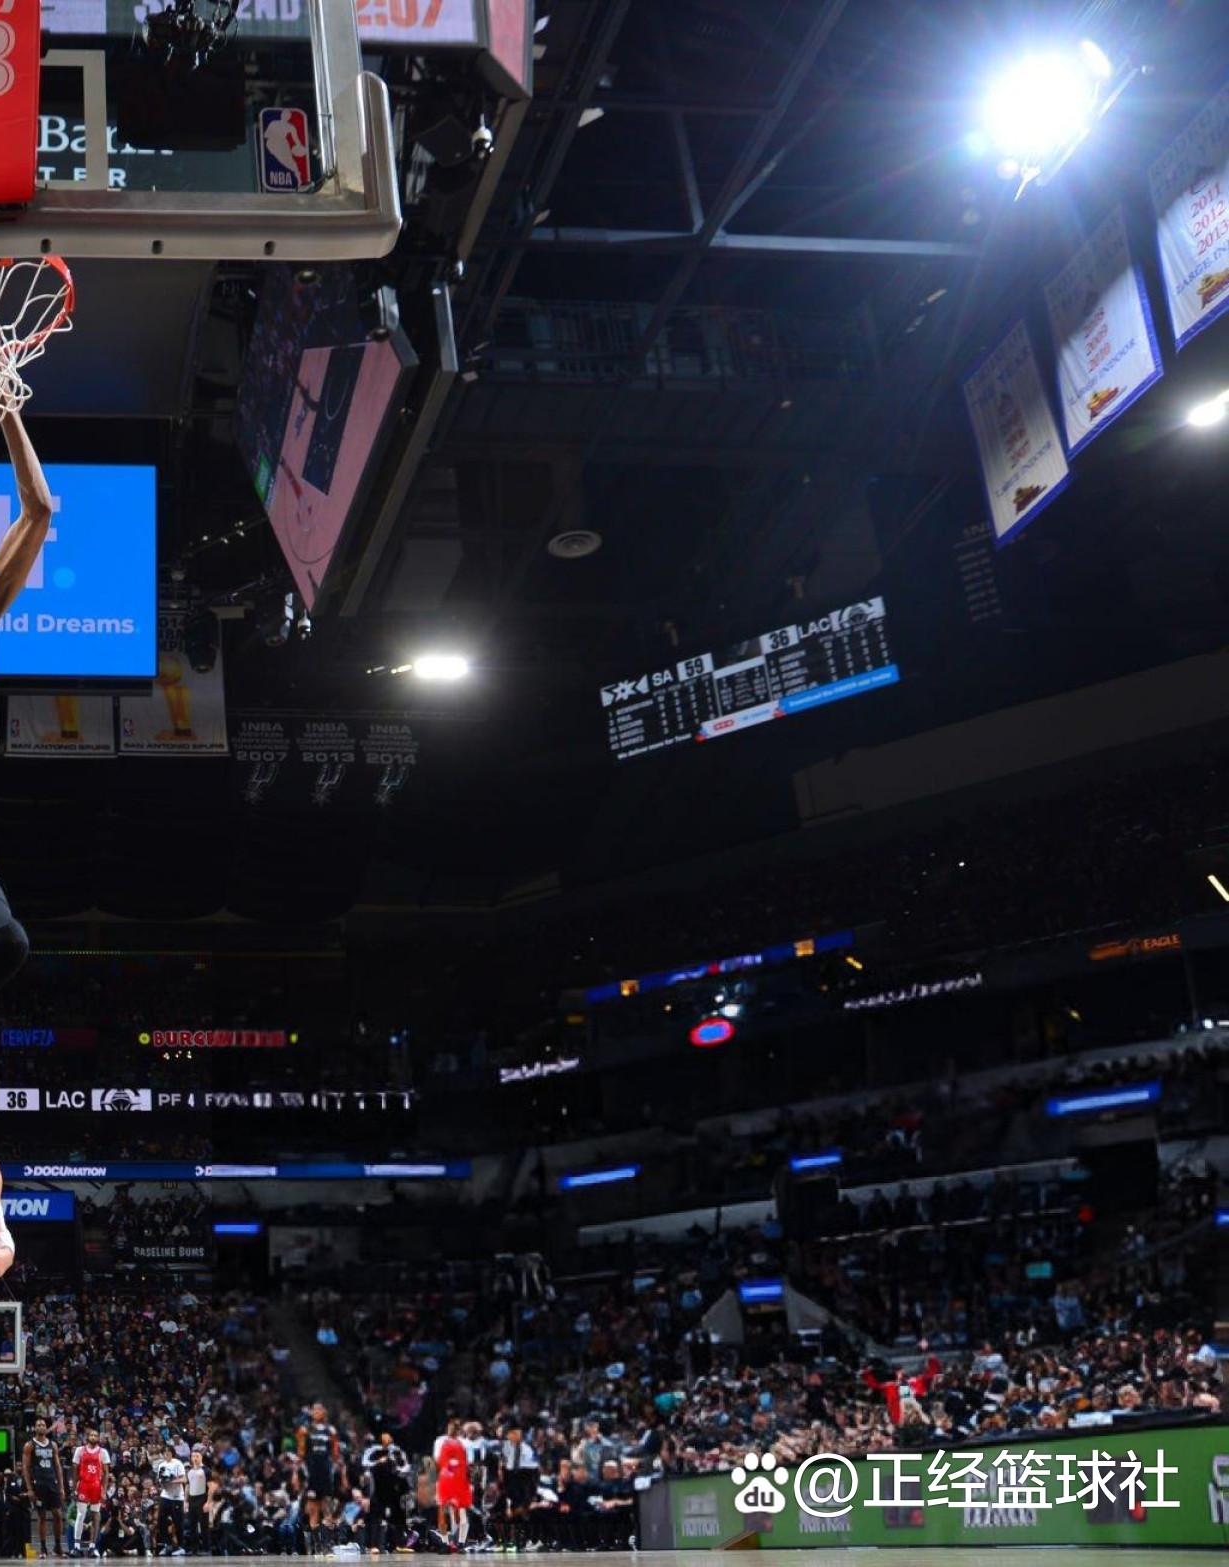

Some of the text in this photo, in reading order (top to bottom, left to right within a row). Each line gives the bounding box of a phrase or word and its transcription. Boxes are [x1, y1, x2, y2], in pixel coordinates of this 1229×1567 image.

[269, 171, 292, 186] NBA
[1193, 200, 1226, 237] 2012
[1197, 218, 1229, 256] 2013
[769, 617, 832, 649] 36 LAC
[651, 658, 704, 687] SA 59
[235, 751, 288, 762] 2007
[302, 752, 356, 763] 2013
[365, 753, 417, 765] 2014
[1143, 934, 1181, 950] EAGLE
[6, 1091, 28, 1110] 36
[45, 1090, 86, 1109] LAC
[158, 1092, 182, 1107] PF
[33, 1166, 107, 1177] DOCUMATION
